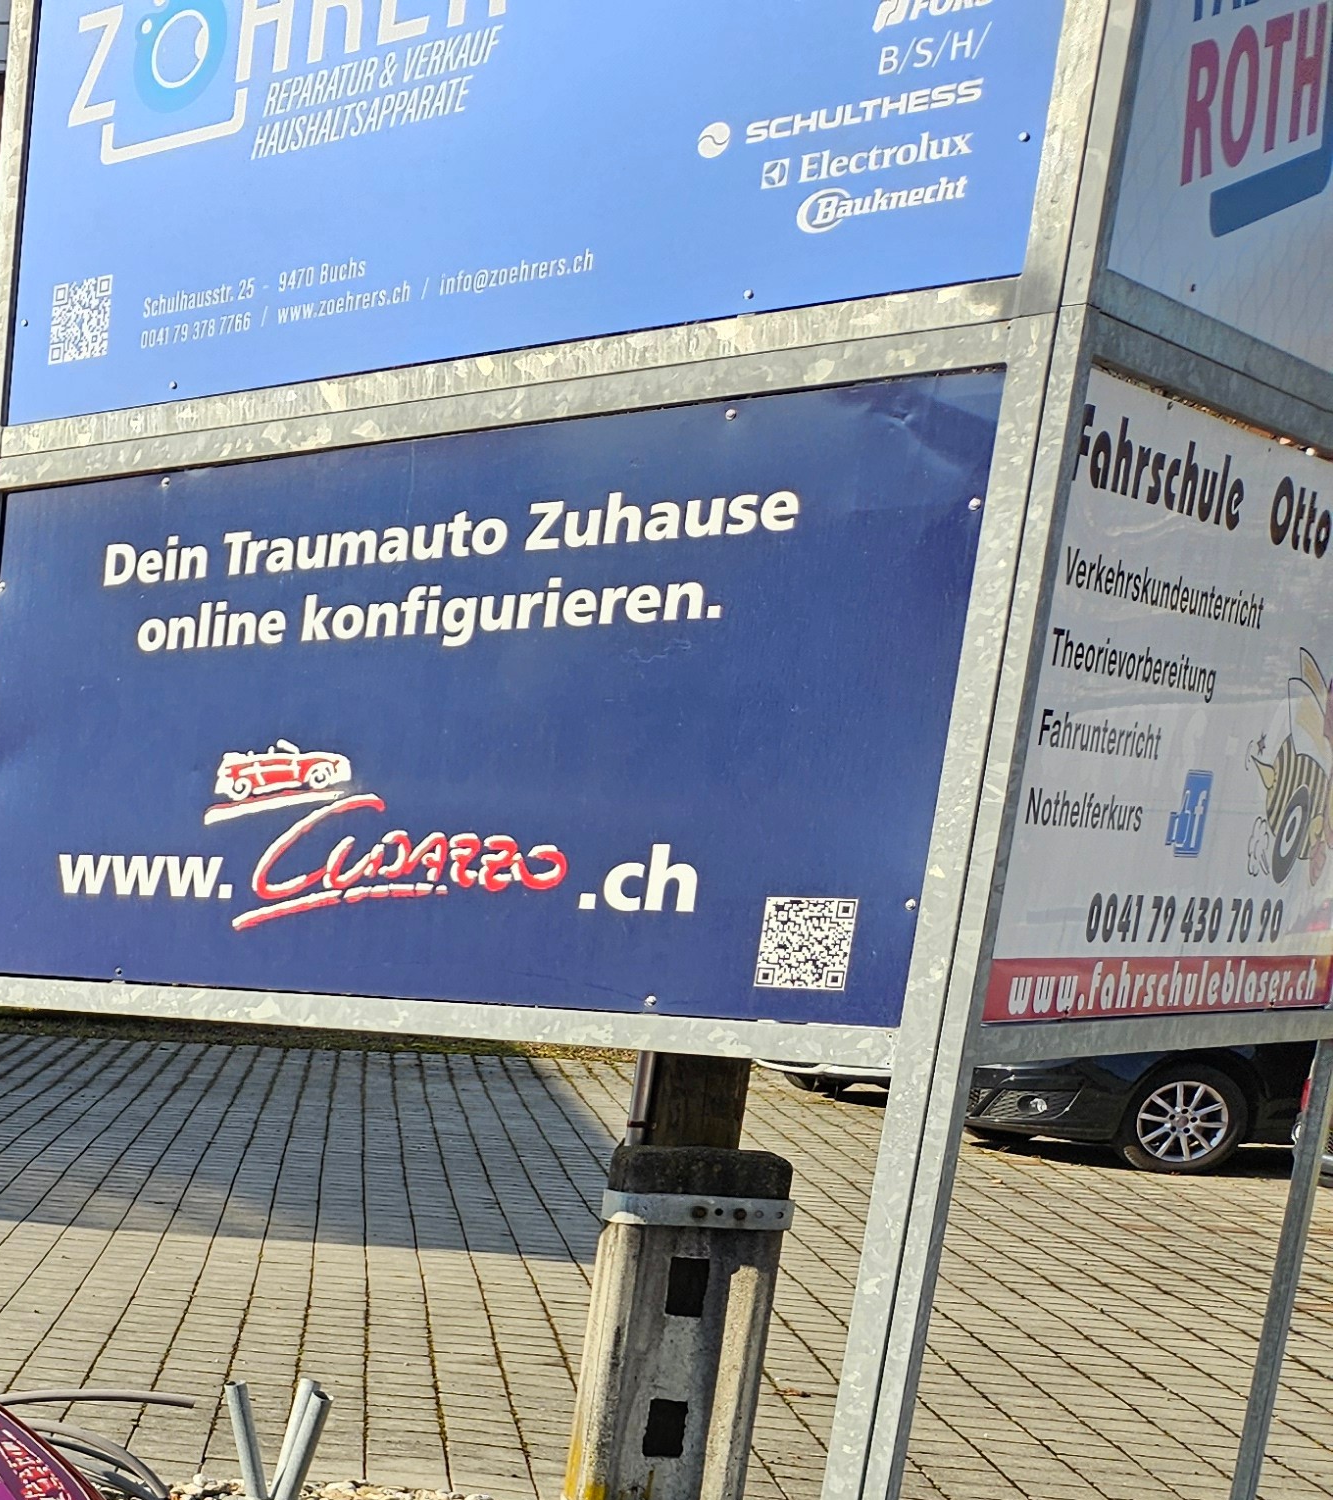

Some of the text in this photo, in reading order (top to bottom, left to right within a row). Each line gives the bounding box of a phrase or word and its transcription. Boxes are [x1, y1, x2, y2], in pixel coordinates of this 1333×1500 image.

[262, 25, 504, 118] REPARATUR & VERKAUF
[878, 21, 993, 75] B/S/H/
[250, 75, 474, 161] HAUSHALTSAPPARATE
[745, 77, 984, 144] SCHULTHESS
[1180, 2, 1327, 187] ROTH
[798, 132, 974, 183] Electrolux
[797, 175, 968, 233] Bauknecht
[140, 325, 170, 349] 0041
[172, 322, 189, 344] 79
[192, 317, 216, 340] 378
[219, 310, 252, 336] 7766
[277, 284, 411, 325] www.zoehrers.ch
[439, 248, 595, 297] info@zoehrers.ch
[142, 284, 235, 318] Schulhausstr.
[237, 277, 256, 301] 25
[278, 263, 315, 292] 9470
[319, 255, 366, 284] Buchs
[1072, 404, 1333, 559] Fahrschule Otto
[102, 490, 799, 587] Dein Traumauto Zuhause
[137, 577, 722, 652] online konfigurieren.
[1066, 546, 1264, 629] Verkehrskundeunterricht
[1051, 628, 1217, 703] Theorievorbereitung
[1038, 709, 1162, 760] Fahrunterricht
[1025, 788, 1143, 832] Nothelferkurs
[1085, 892, 1284, 943] 0041 79 430 70 90
[1007, 957, 1318, 1015] www.fahrschuleblaser.ch
